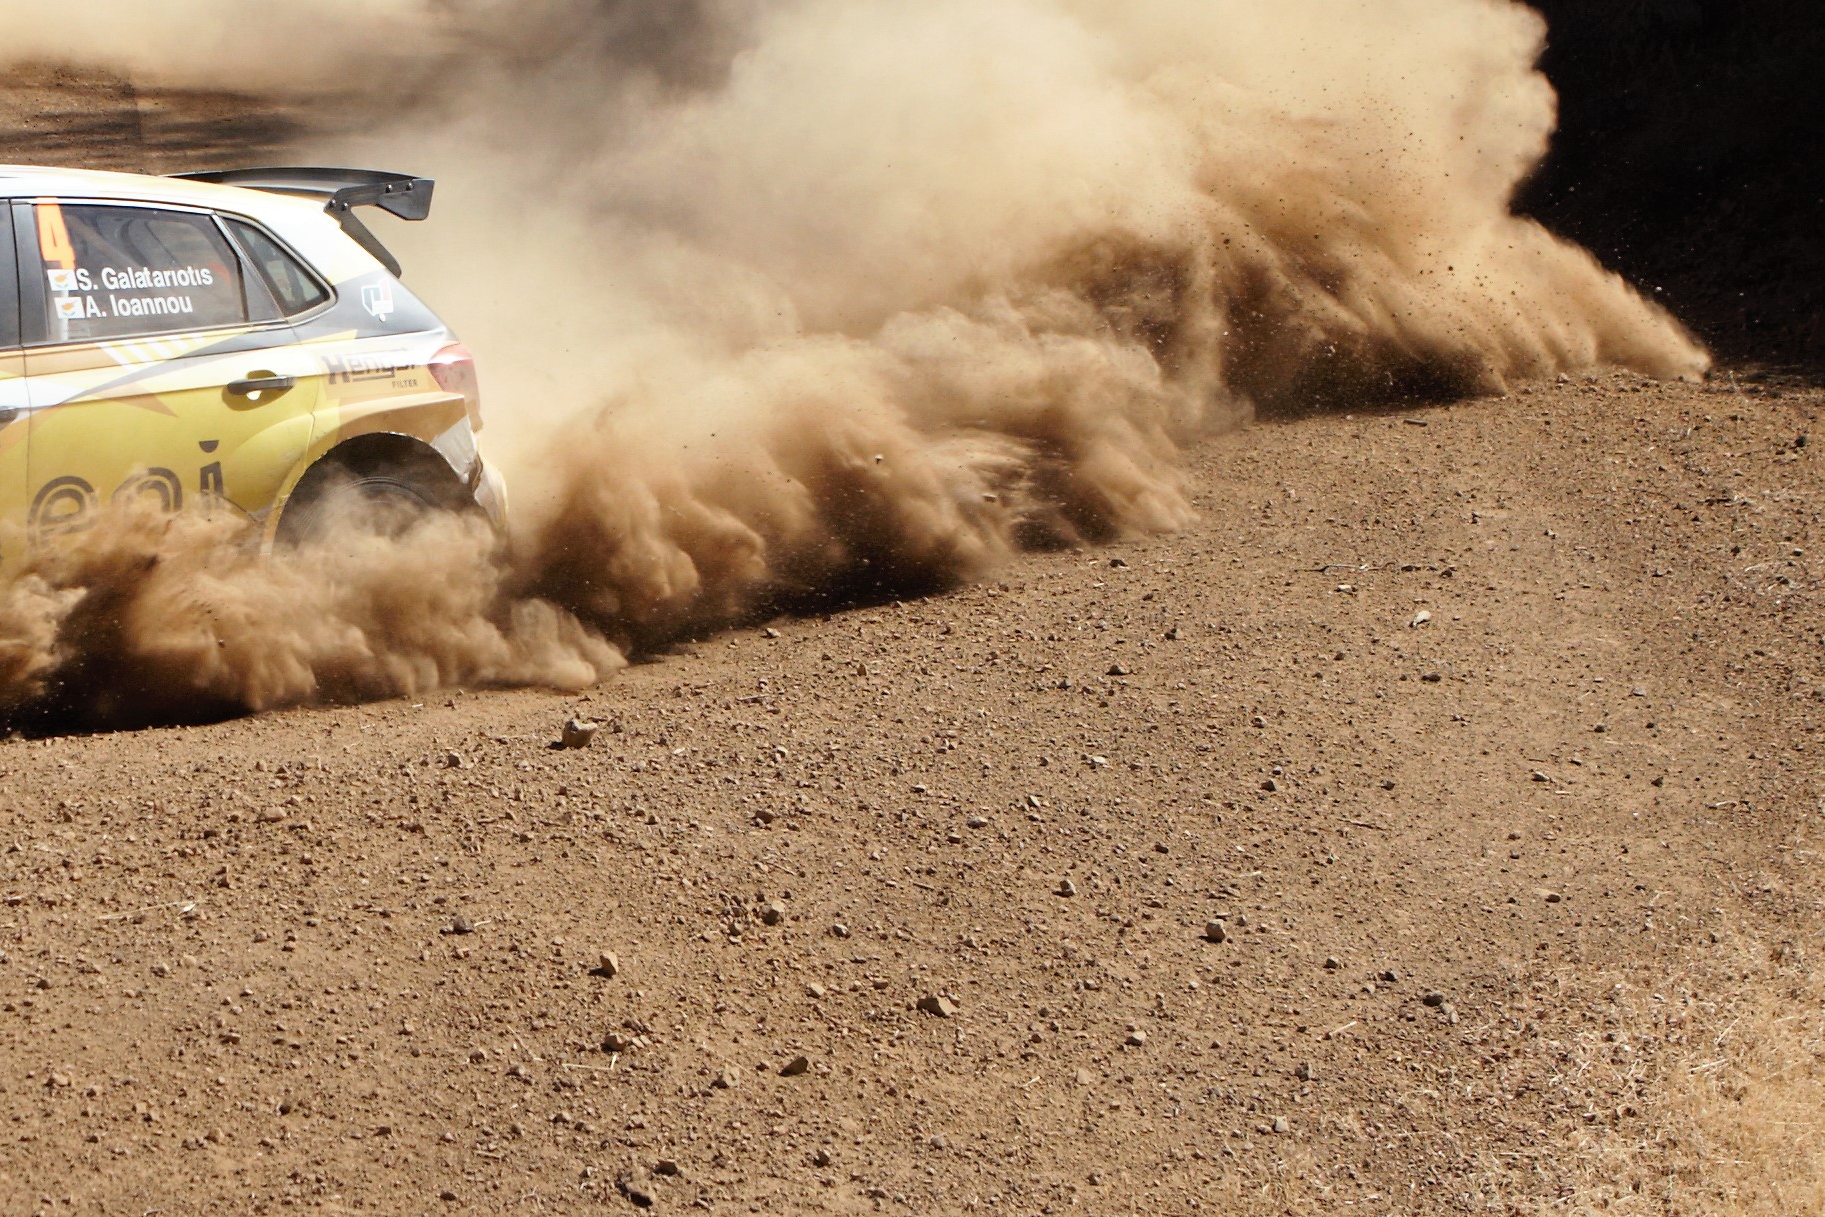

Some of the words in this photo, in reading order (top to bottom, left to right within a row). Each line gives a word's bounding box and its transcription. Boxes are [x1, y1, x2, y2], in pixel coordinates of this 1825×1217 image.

[36, 198, 76, 270] 4
[76, 267, 99, 292] S.
[101, 266, 214, 290] Galatariotis
[86, 296, 107, 318] A.
[109, 294, 193, 317] Ioannou
